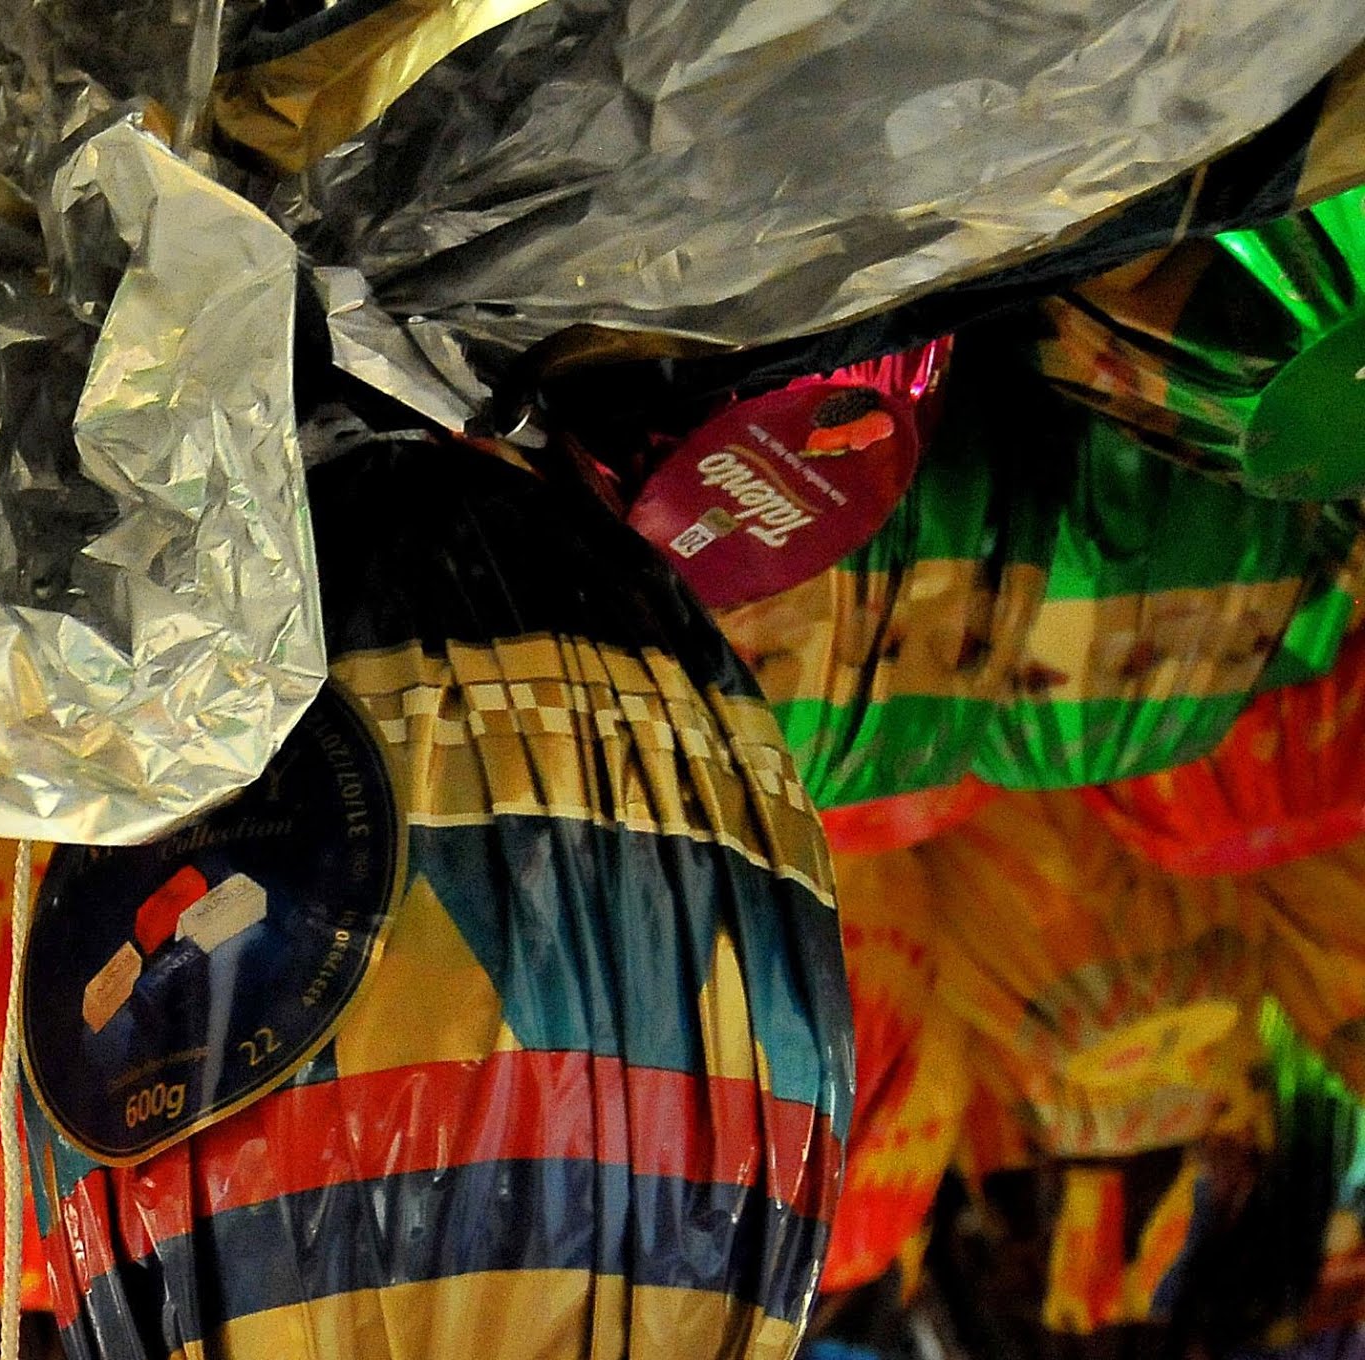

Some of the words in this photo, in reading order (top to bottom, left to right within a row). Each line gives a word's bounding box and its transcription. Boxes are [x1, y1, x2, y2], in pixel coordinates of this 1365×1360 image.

[698, 453, 814, 548] Talento
[237, 1027, 282, 1067] 22
[125, 1082, 187, 1128] 600g
